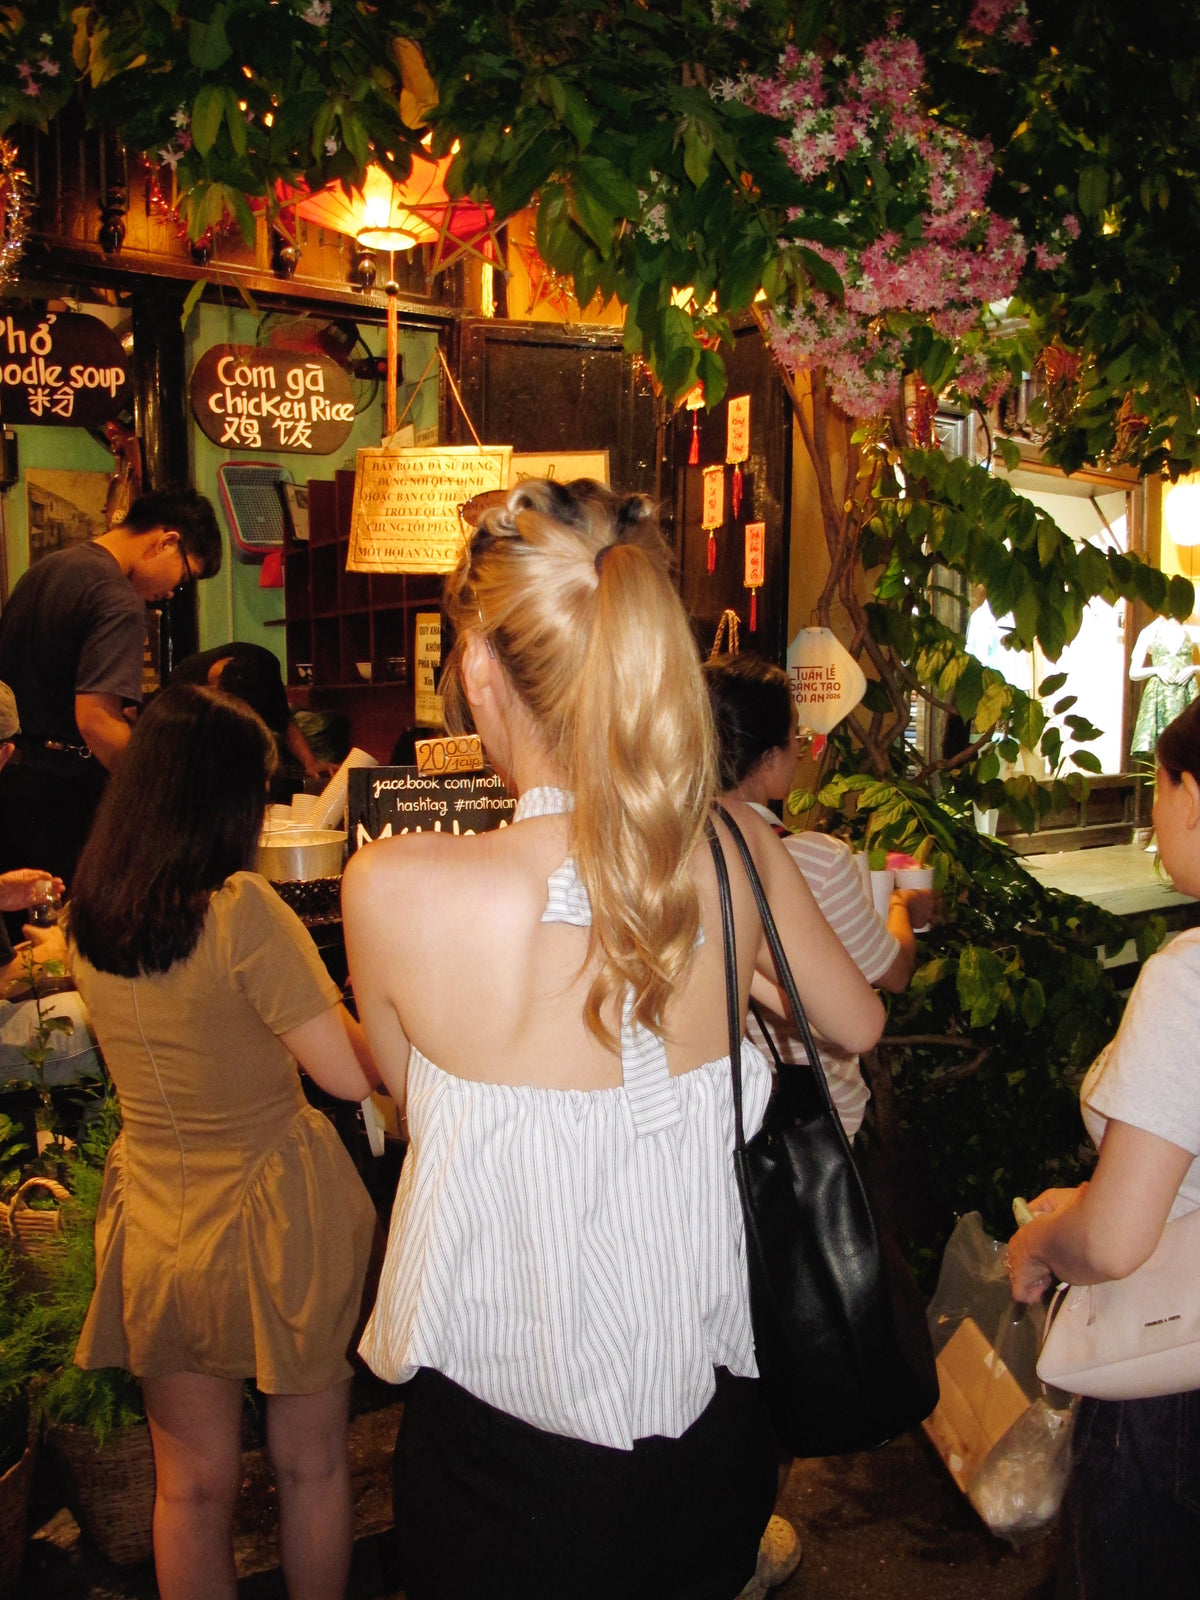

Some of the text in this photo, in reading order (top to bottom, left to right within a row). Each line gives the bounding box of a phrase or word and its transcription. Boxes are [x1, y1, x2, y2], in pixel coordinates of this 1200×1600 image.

[70, 365, 126, 398] soup
[28, 386, 74, 418] 粉
[310, 396, 355, 422] Rice
[810, 694, 825, 703] AN
[820, 682, 841, 694] TẠO
[397, 797, 449, 817] hashtag
